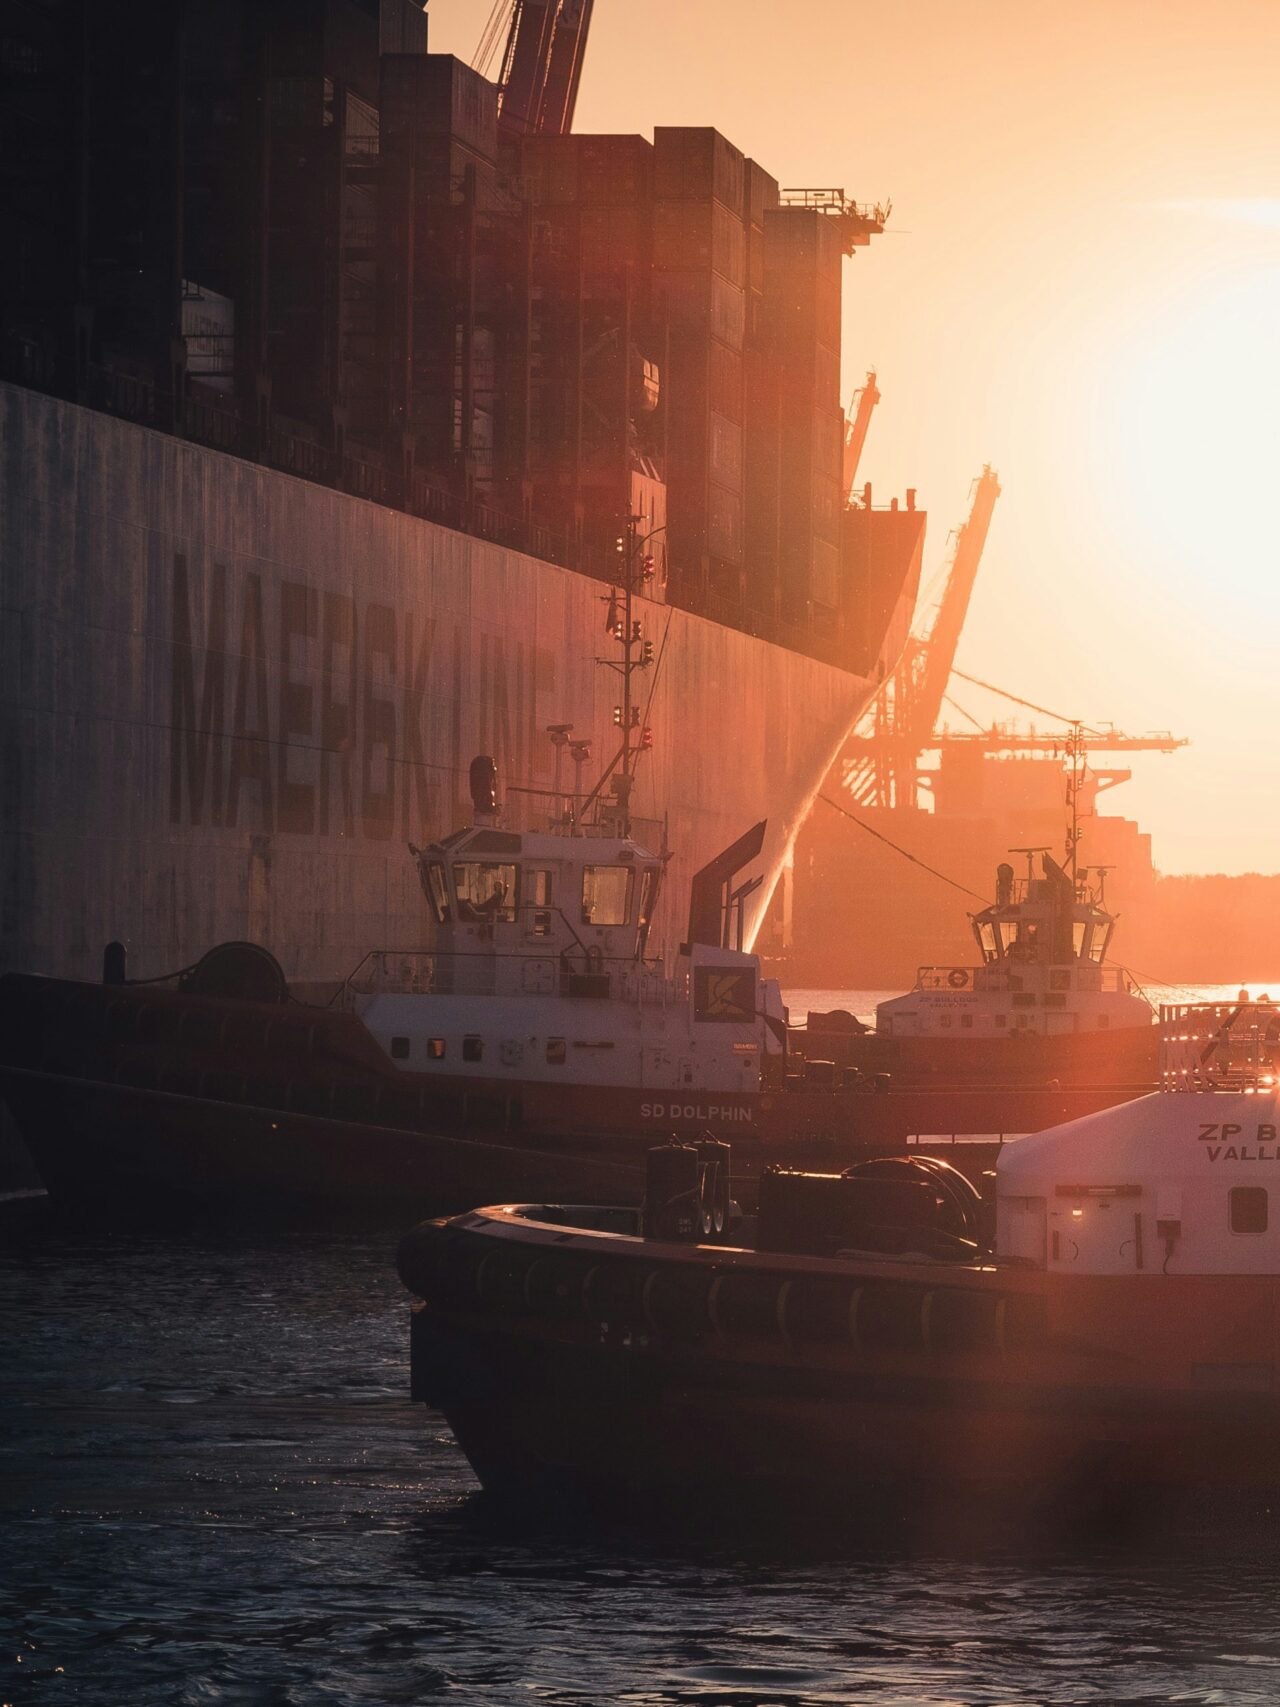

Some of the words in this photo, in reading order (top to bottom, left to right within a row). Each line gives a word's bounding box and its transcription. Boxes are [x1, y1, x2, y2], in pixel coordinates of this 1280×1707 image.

[169, 554, 437, 842] MAERSK
[640, 1103, 665, 1117] SD
[669, 1104, 752, 1121] DOLPHIN
[1197, 1123, 1242, 1141] ZP
